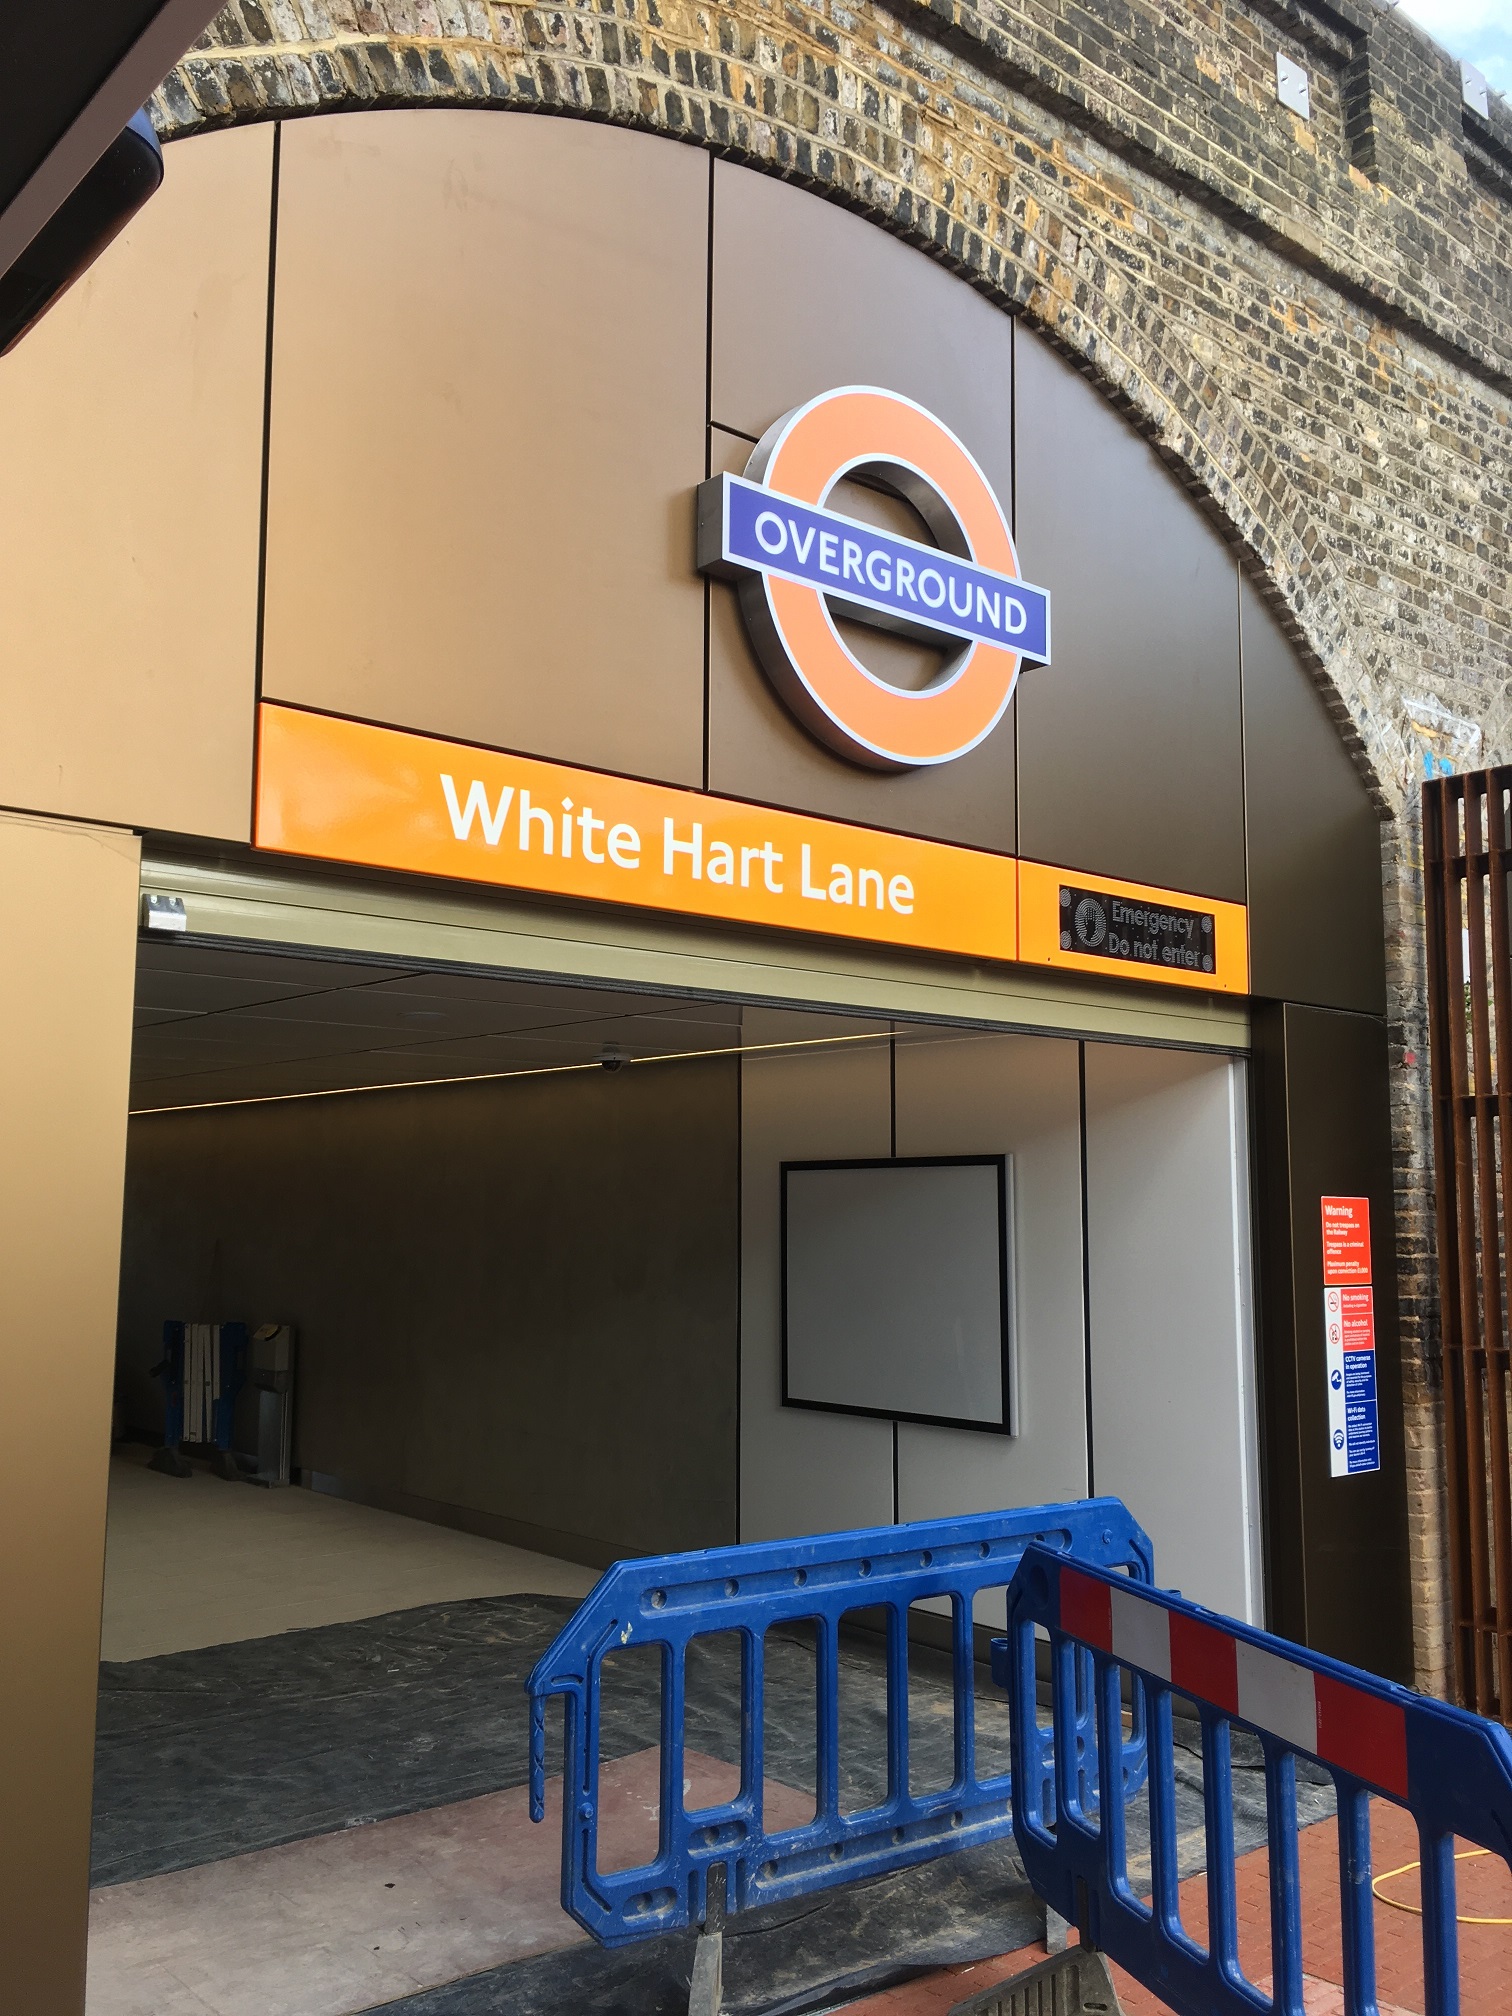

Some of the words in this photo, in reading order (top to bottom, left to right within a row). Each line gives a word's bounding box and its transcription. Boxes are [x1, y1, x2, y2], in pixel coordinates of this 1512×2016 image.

[754, 511, 1028, 635] OVERGROUND
[439, 773, 641, 869] White
[663, 816, 783, 894] Hart
[801, 843, 915, 915] Lane
[1112, 900, 1194, 939] Emergency
[1108, 932, 1130, 956] Do
[1133, 939, 1158, 960] not
[1162, 944, 1201, 967] enter
[1324, 1205, 1353, 1219] Warning
[1350, 1293, 1369, 1302] smoking
[1351, 1319, 1369, 1327] alcohol
[1350, 1362, 1367, 1370] operation
